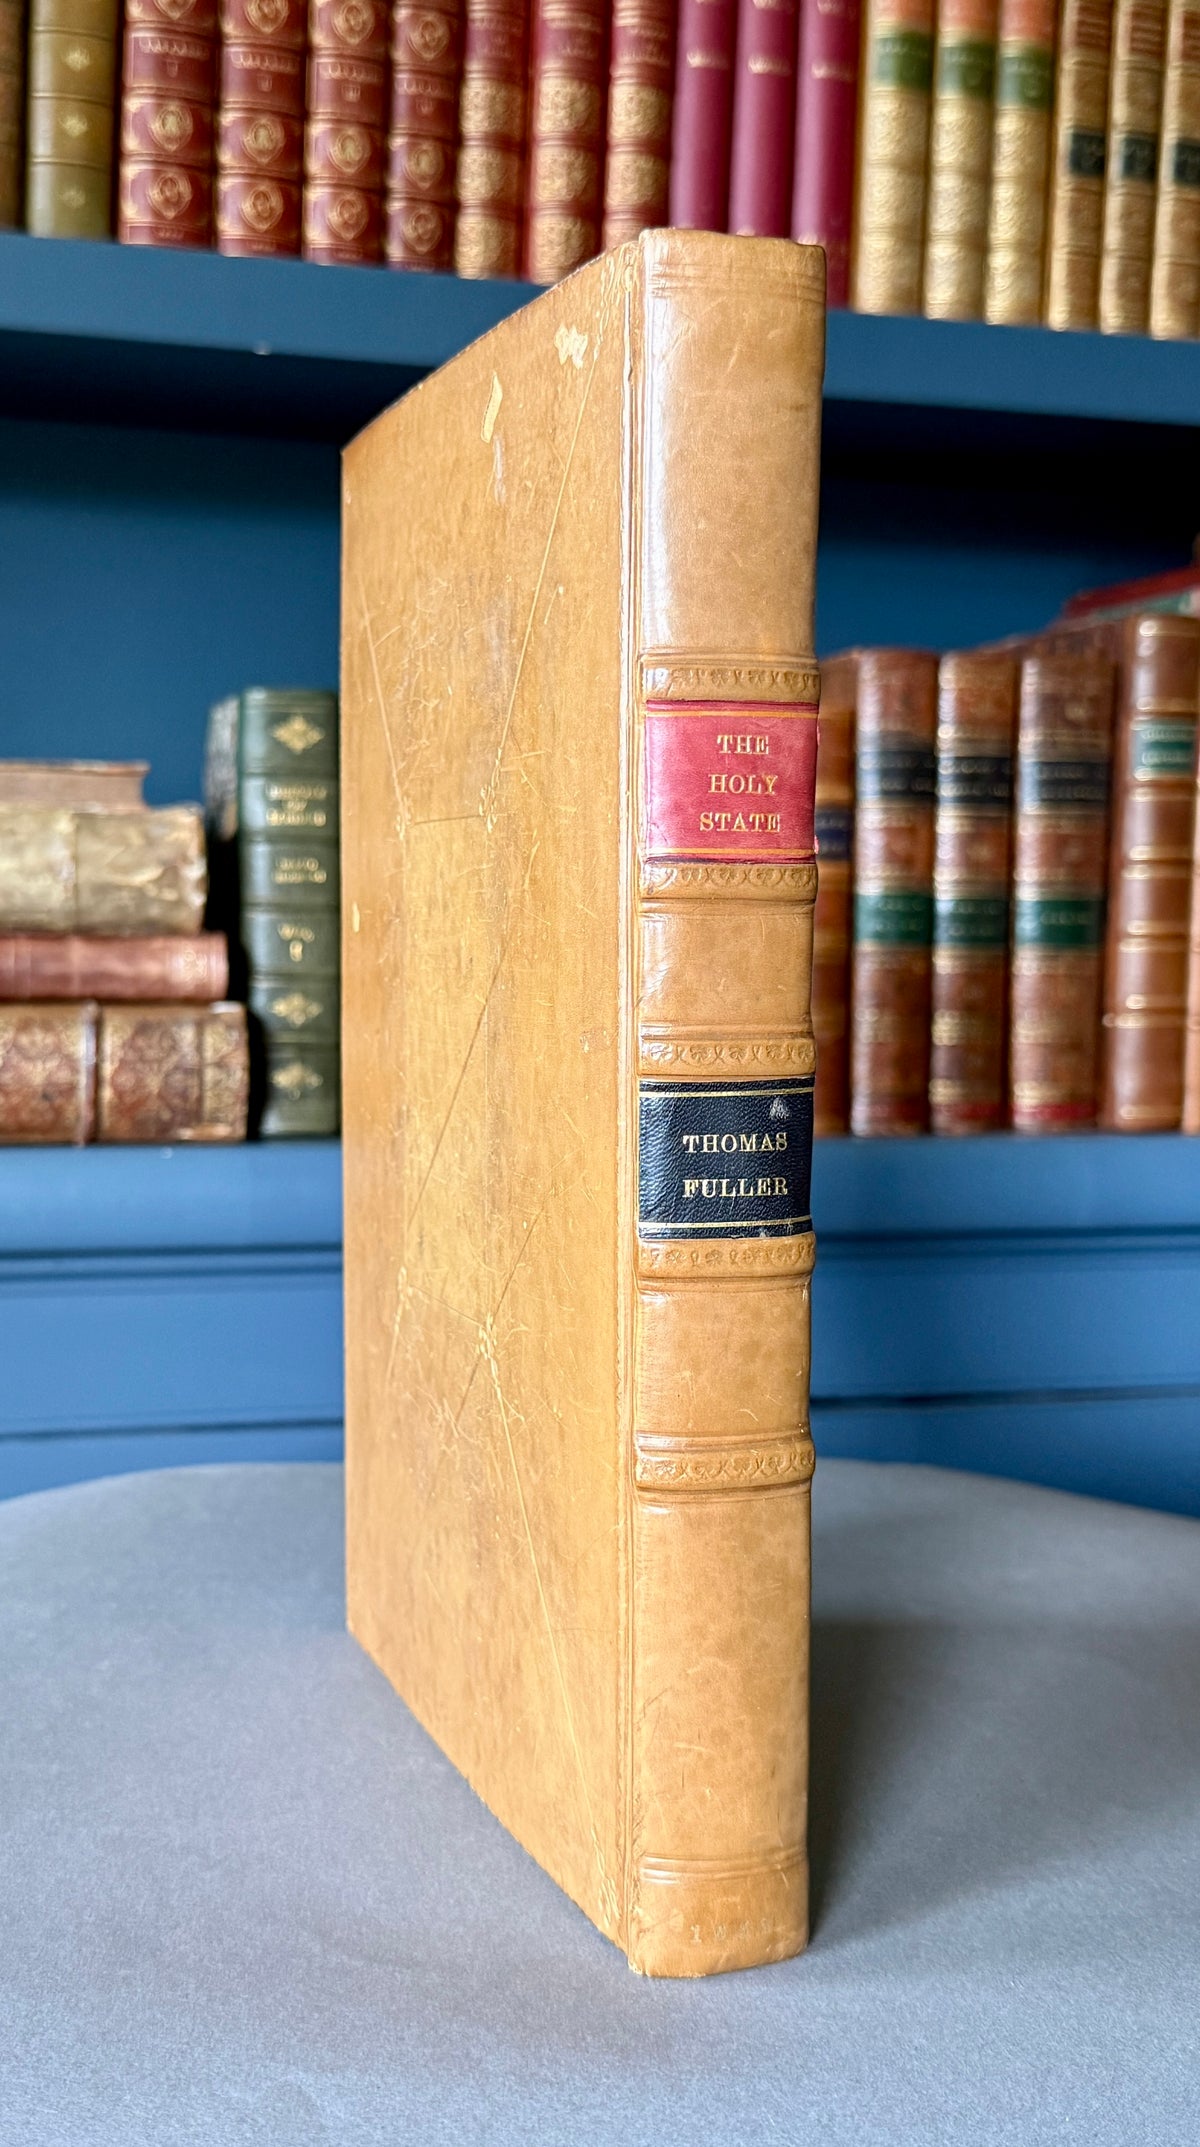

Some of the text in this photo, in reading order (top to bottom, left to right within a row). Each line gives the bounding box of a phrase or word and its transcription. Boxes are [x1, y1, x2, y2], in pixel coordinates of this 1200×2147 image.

[716, 734, 769, 755] THE
[708, 773, 778, 795] HOLY
[699, 811, 781, 833] STATE
[682, 1131, 788, 1153] THOMAS
[682, 1176, 788, 1198] FULLER
